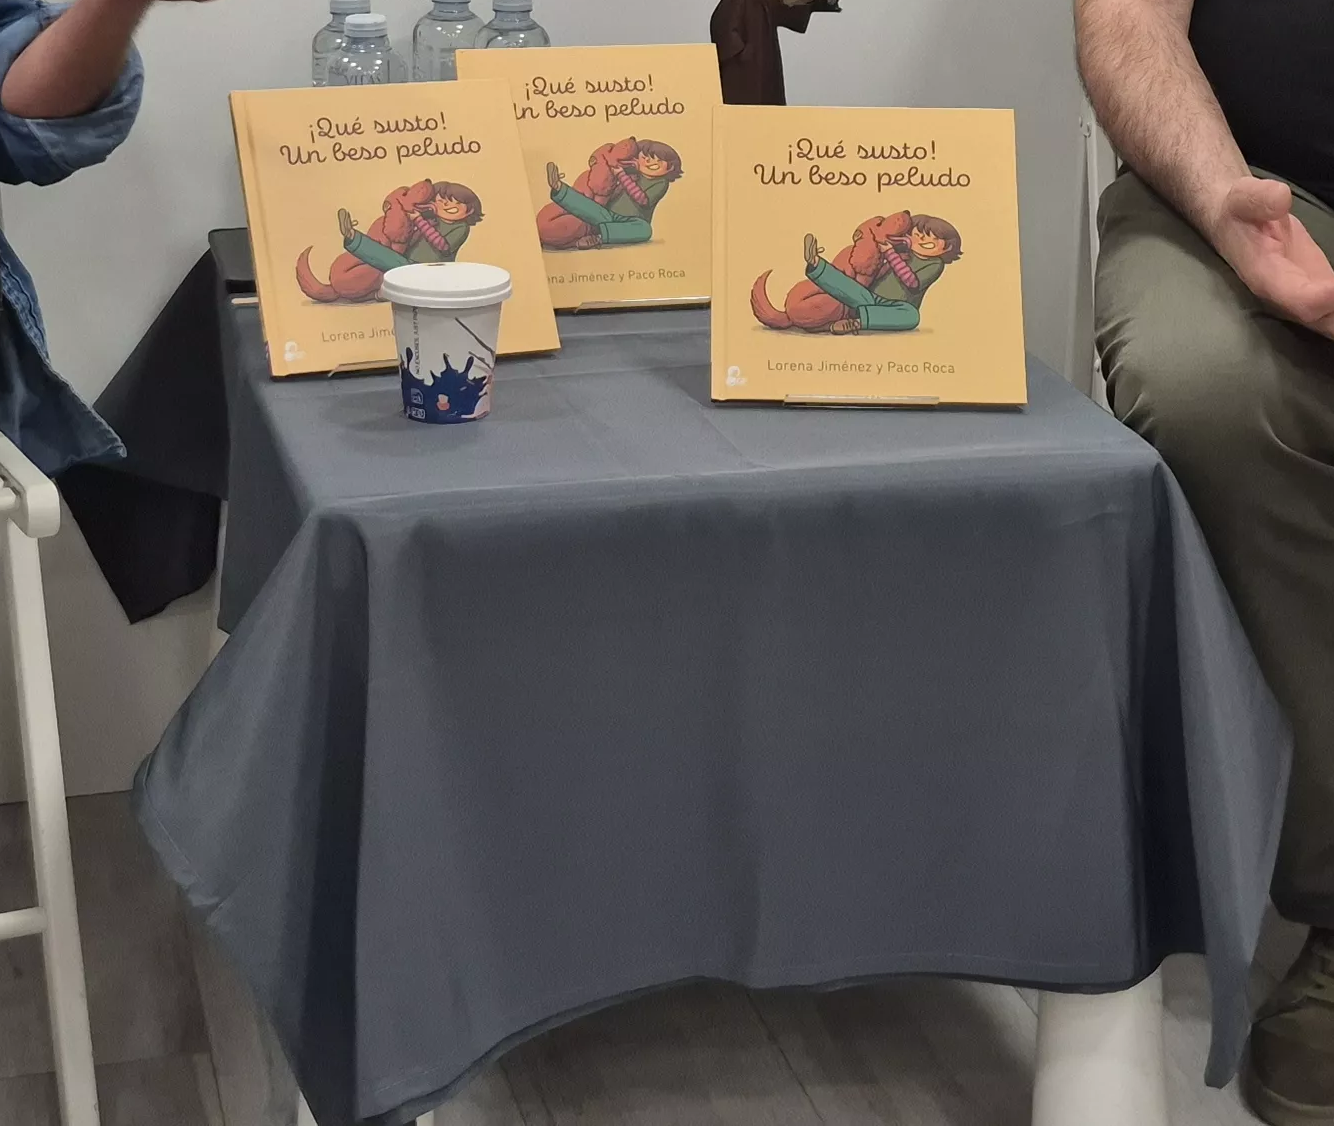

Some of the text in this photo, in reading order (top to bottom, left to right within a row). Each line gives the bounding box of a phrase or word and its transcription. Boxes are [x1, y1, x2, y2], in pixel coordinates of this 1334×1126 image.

[524, 75, 654, 100] ¡Qué susto!
[546, 100, 597, 119] beso
[604, 98, 685, 122] peludo
[308, 111, 447, 143] ¡Qué susto!
[279, 136, 482, 166] Un beso peludo
[787, 138, 937, 165] ¡Qué susto!
[754, 163, 971, 193] Un beso peludo
[568, 270, 615, 284] Jiménez
[618, 274, 625, 285] y
[628, 269, 655, 281] Paco
[658, 268, 686, 280] Roca
[322, 329, 365, 343] Lorena
[767, 360, 955, 375] Lorena Jiménez y Paco Roca
